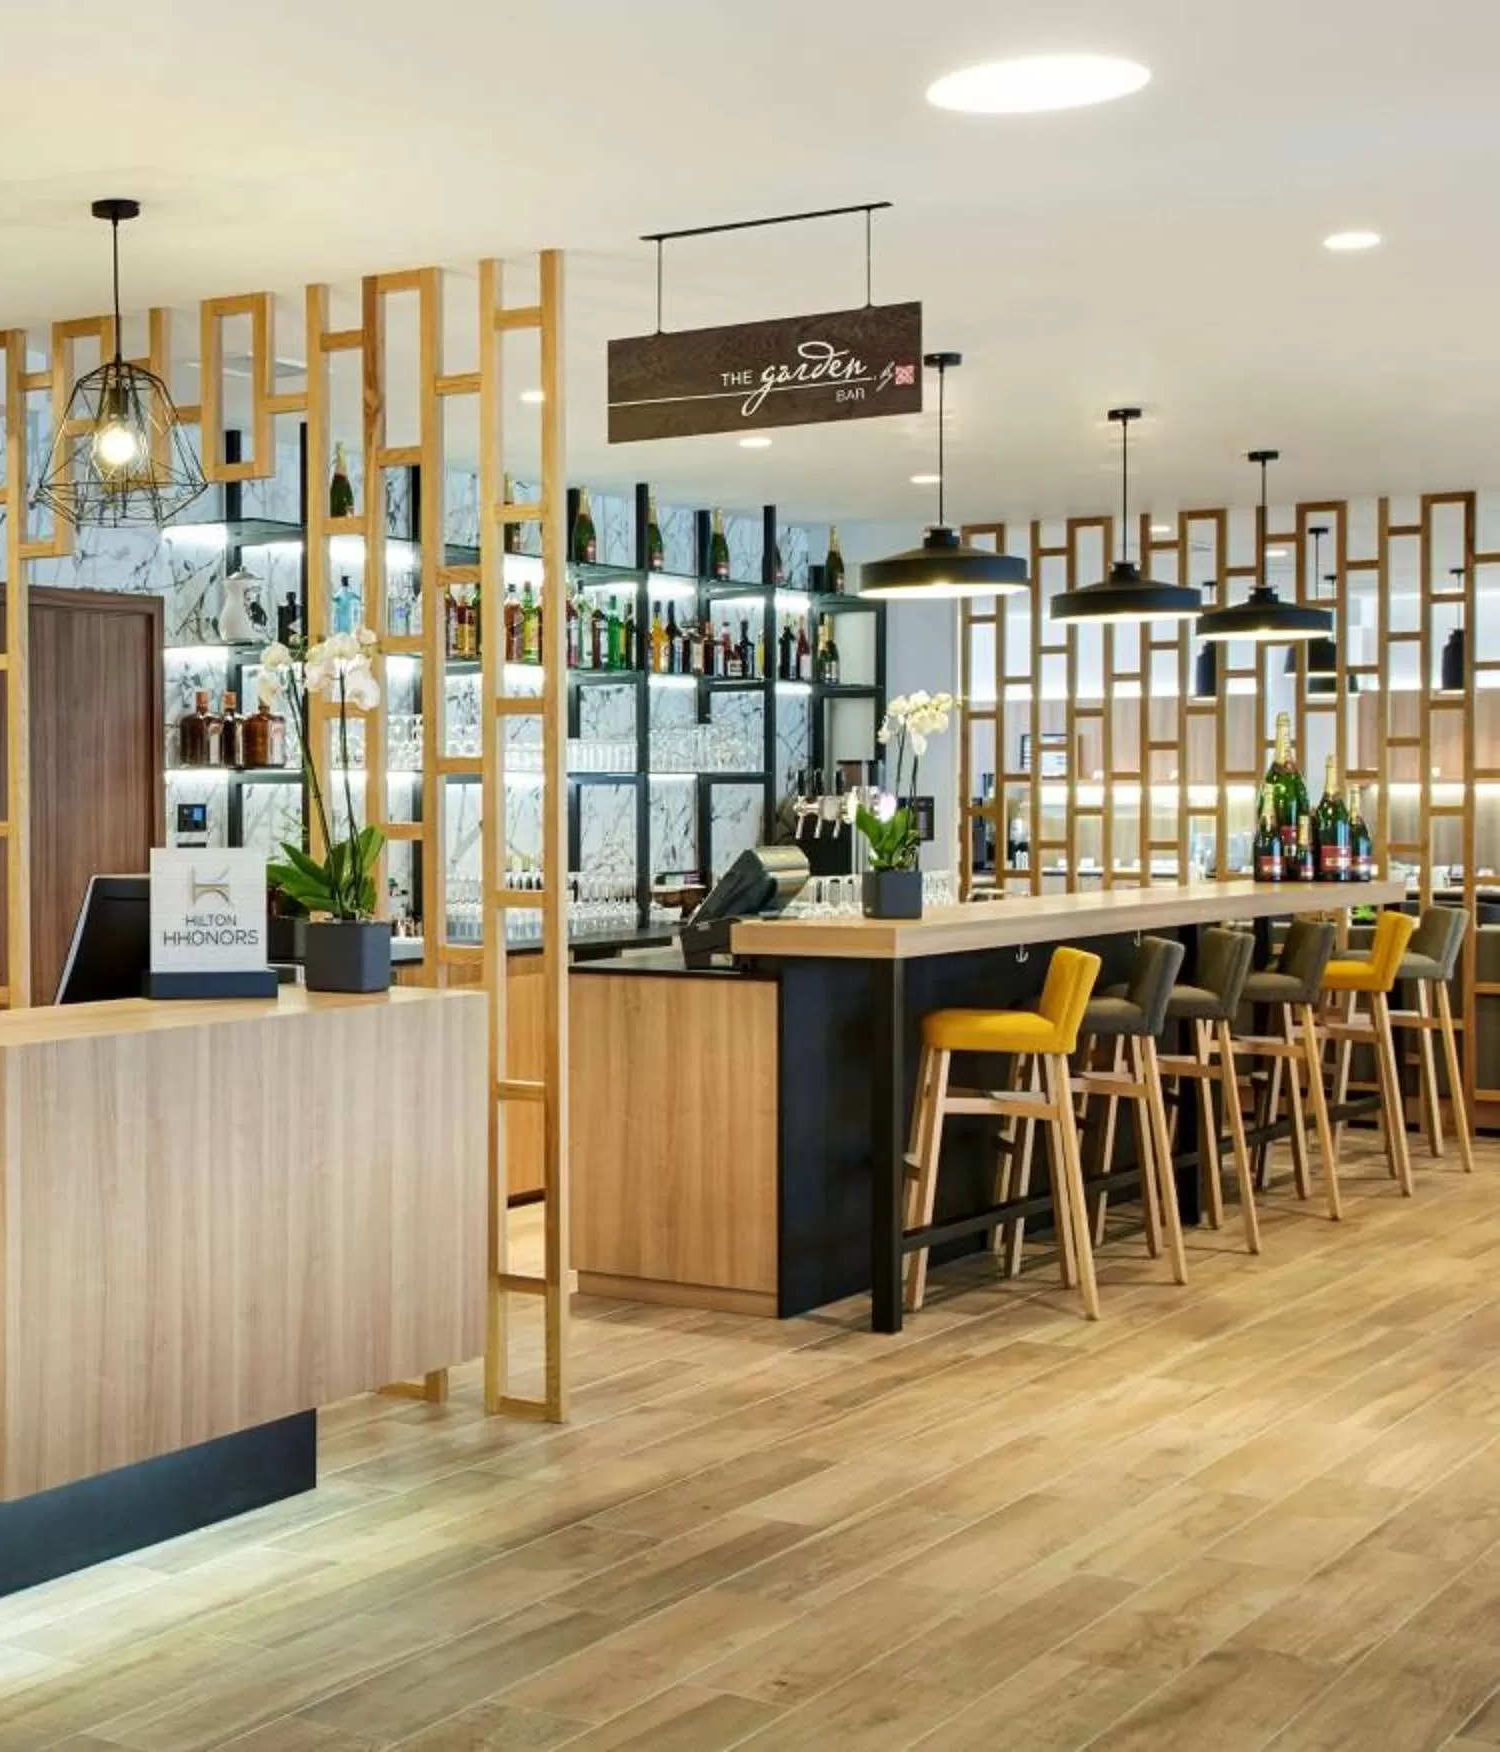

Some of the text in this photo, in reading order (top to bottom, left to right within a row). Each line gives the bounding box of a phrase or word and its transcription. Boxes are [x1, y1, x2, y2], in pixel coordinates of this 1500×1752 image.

[720, 368, 753, 387] THE
[741, 341, 867, 417] garden
[835, 387, 866, 404] BAR
[183, 912, 238, 928] HILTON
[162, 928, 260, 947] HHONORS
